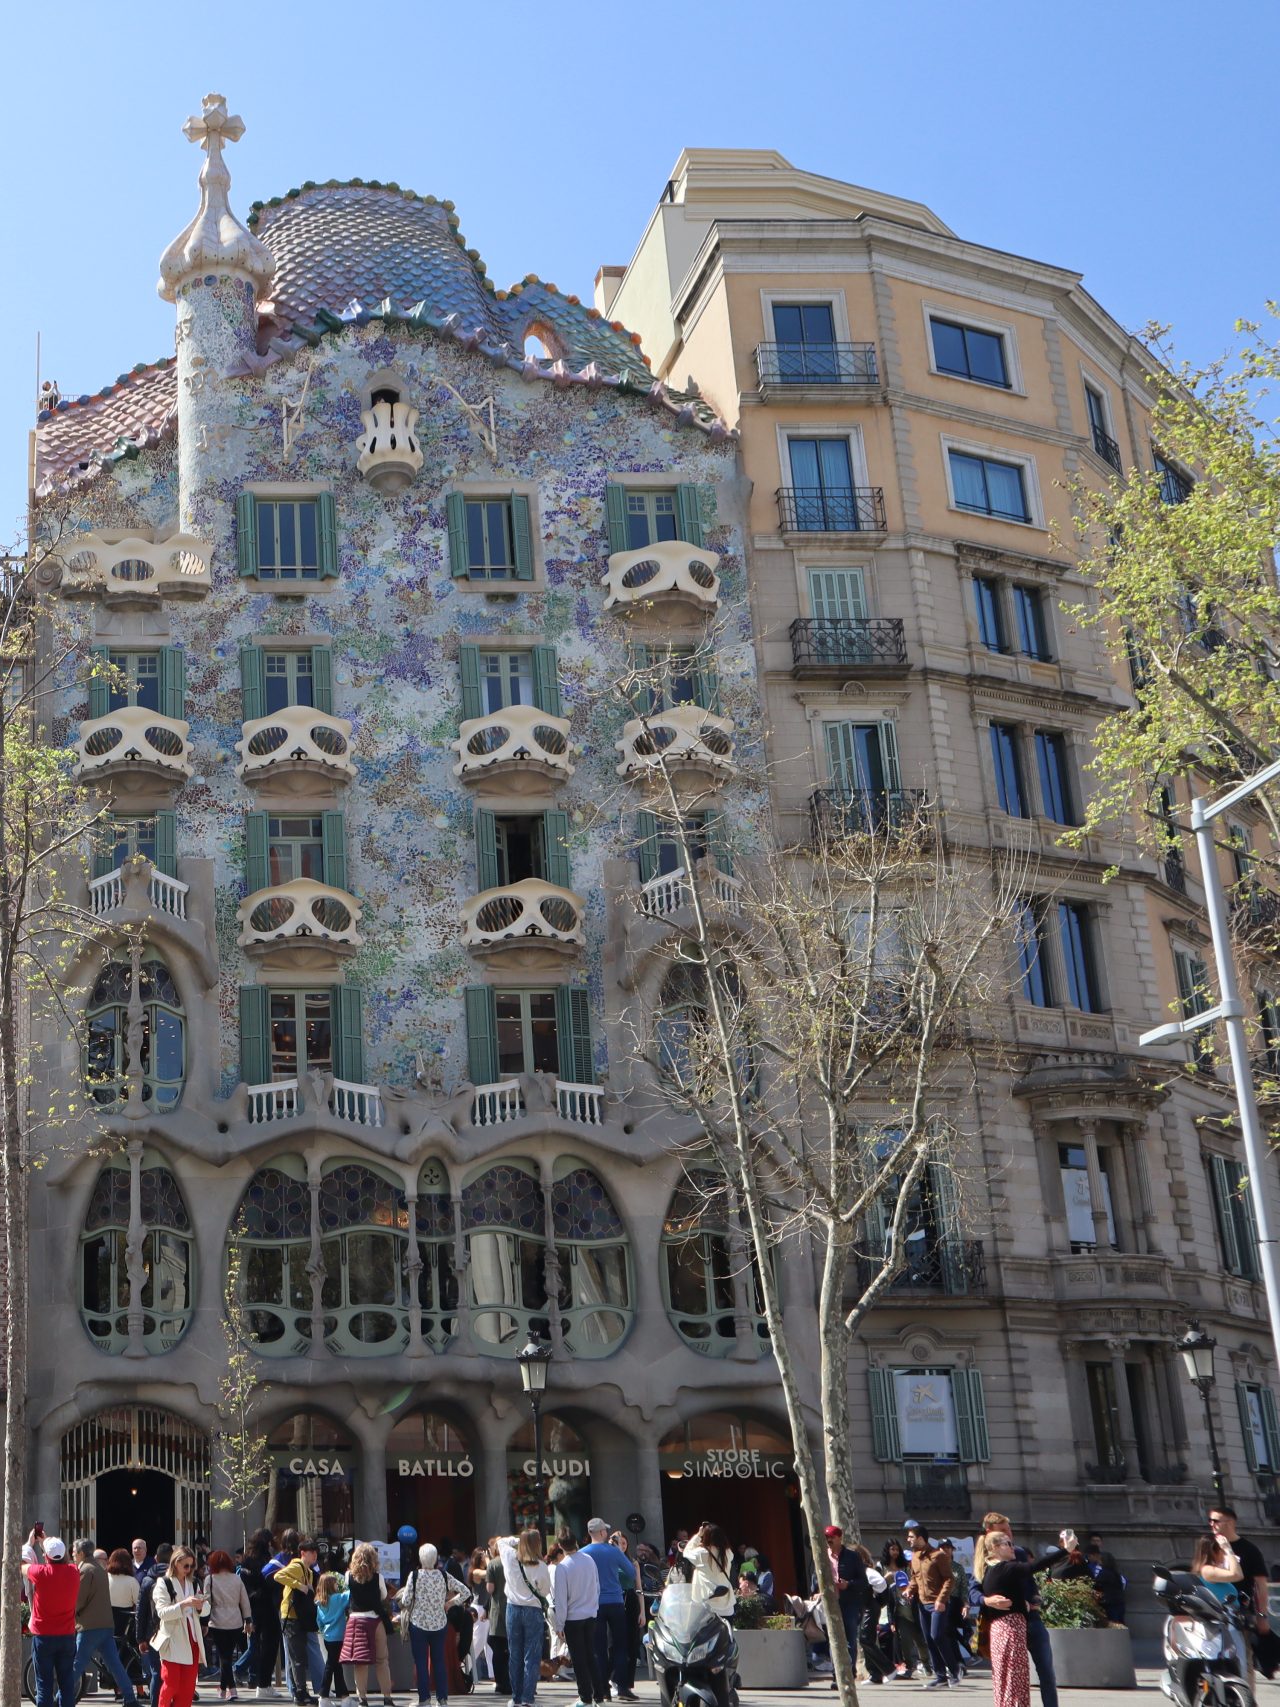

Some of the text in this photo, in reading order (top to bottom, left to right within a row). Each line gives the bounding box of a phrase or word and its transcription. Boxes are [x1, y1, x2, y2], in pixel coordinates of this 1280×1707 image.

[706, 1449, 760, 1462] STORE
[289, 1457, 345, 1476] CASA
[398, 1454, 474, 1477] BATLLÓ
[683, 1460, 786, 1479] SIMBOLIC
